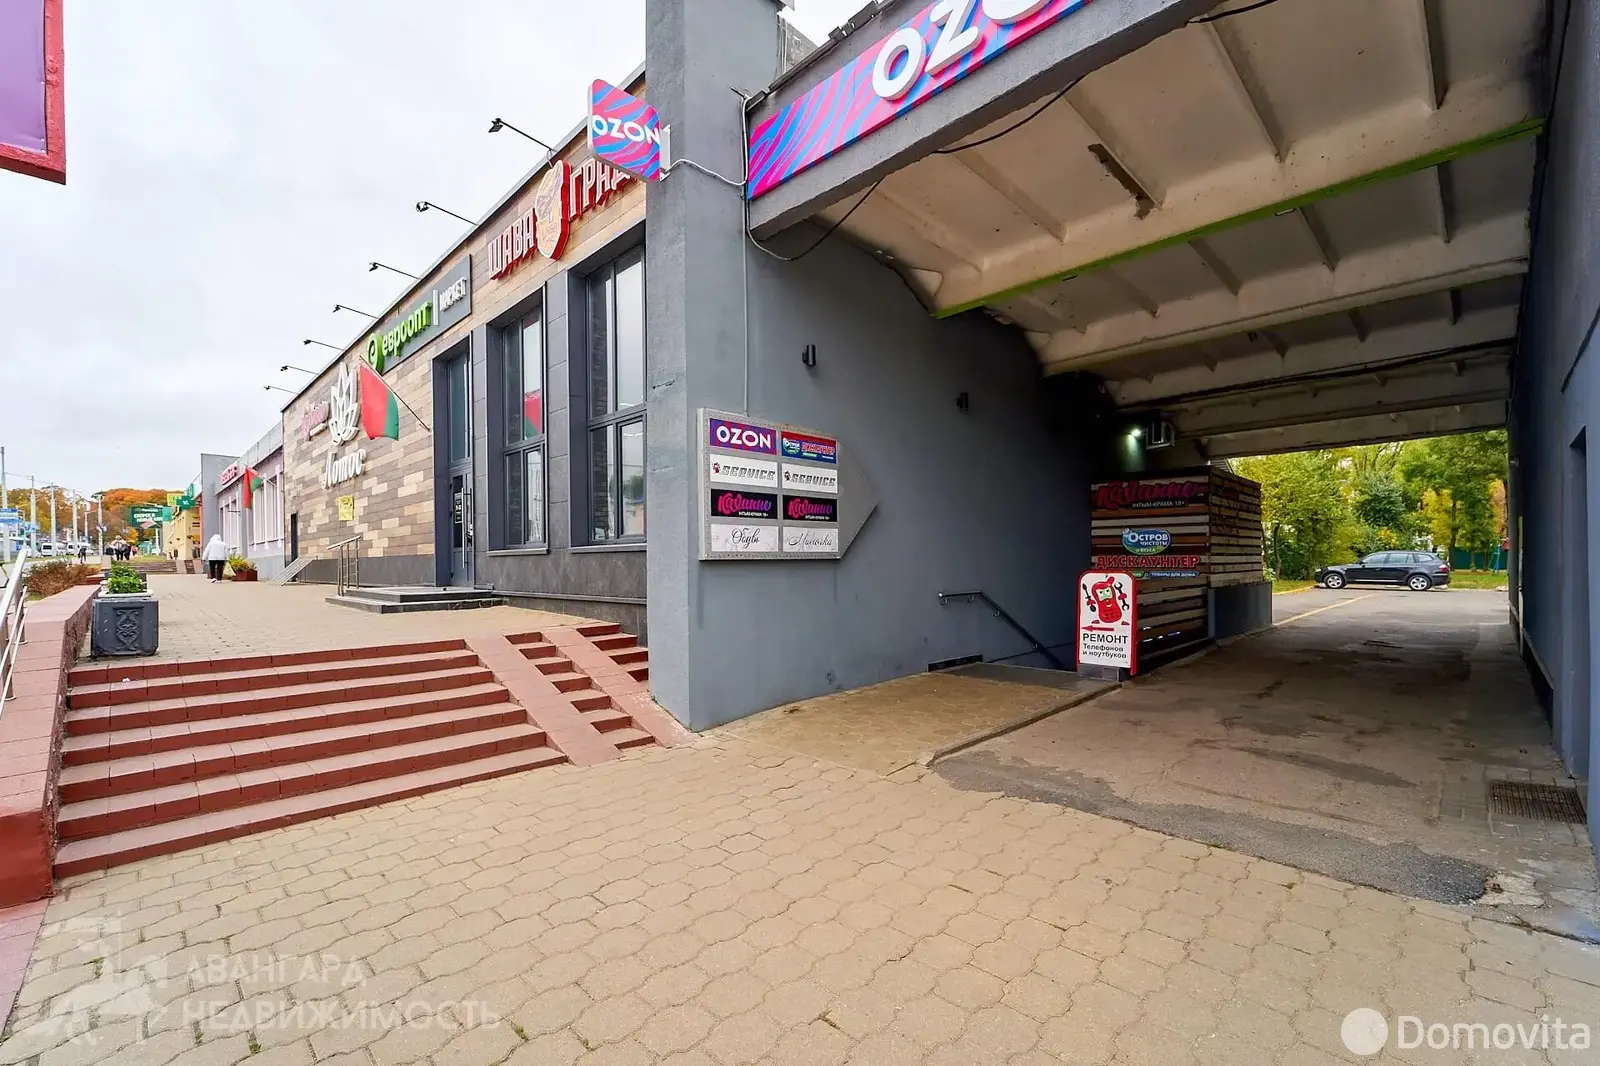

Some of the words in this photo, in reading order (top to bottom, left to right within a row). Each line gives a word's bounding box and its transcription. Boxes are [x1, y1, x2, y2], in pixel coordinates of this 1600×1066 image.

[592, 115, 660, 146] OZON
[488, 208, 537, 280] ШАВА
[382, 300, 433, 357] евроопт
[716, 425, 771, 450] OZON
[319, 449, 366, 490] Лотос
[720, 465, 776, 481] SERVICE
[791, 473, 836, 487] SERVICE
[731, 527, 760, 550] Обувь
[1096, 555, 1200, 570] ДИСКАУНТЕР
[1083, 633, 1128, 644] РЕМОНТ
[1083, 643, 1124, 652] Телефонов
[1089, 651, 1127, 659] ноутбуков
